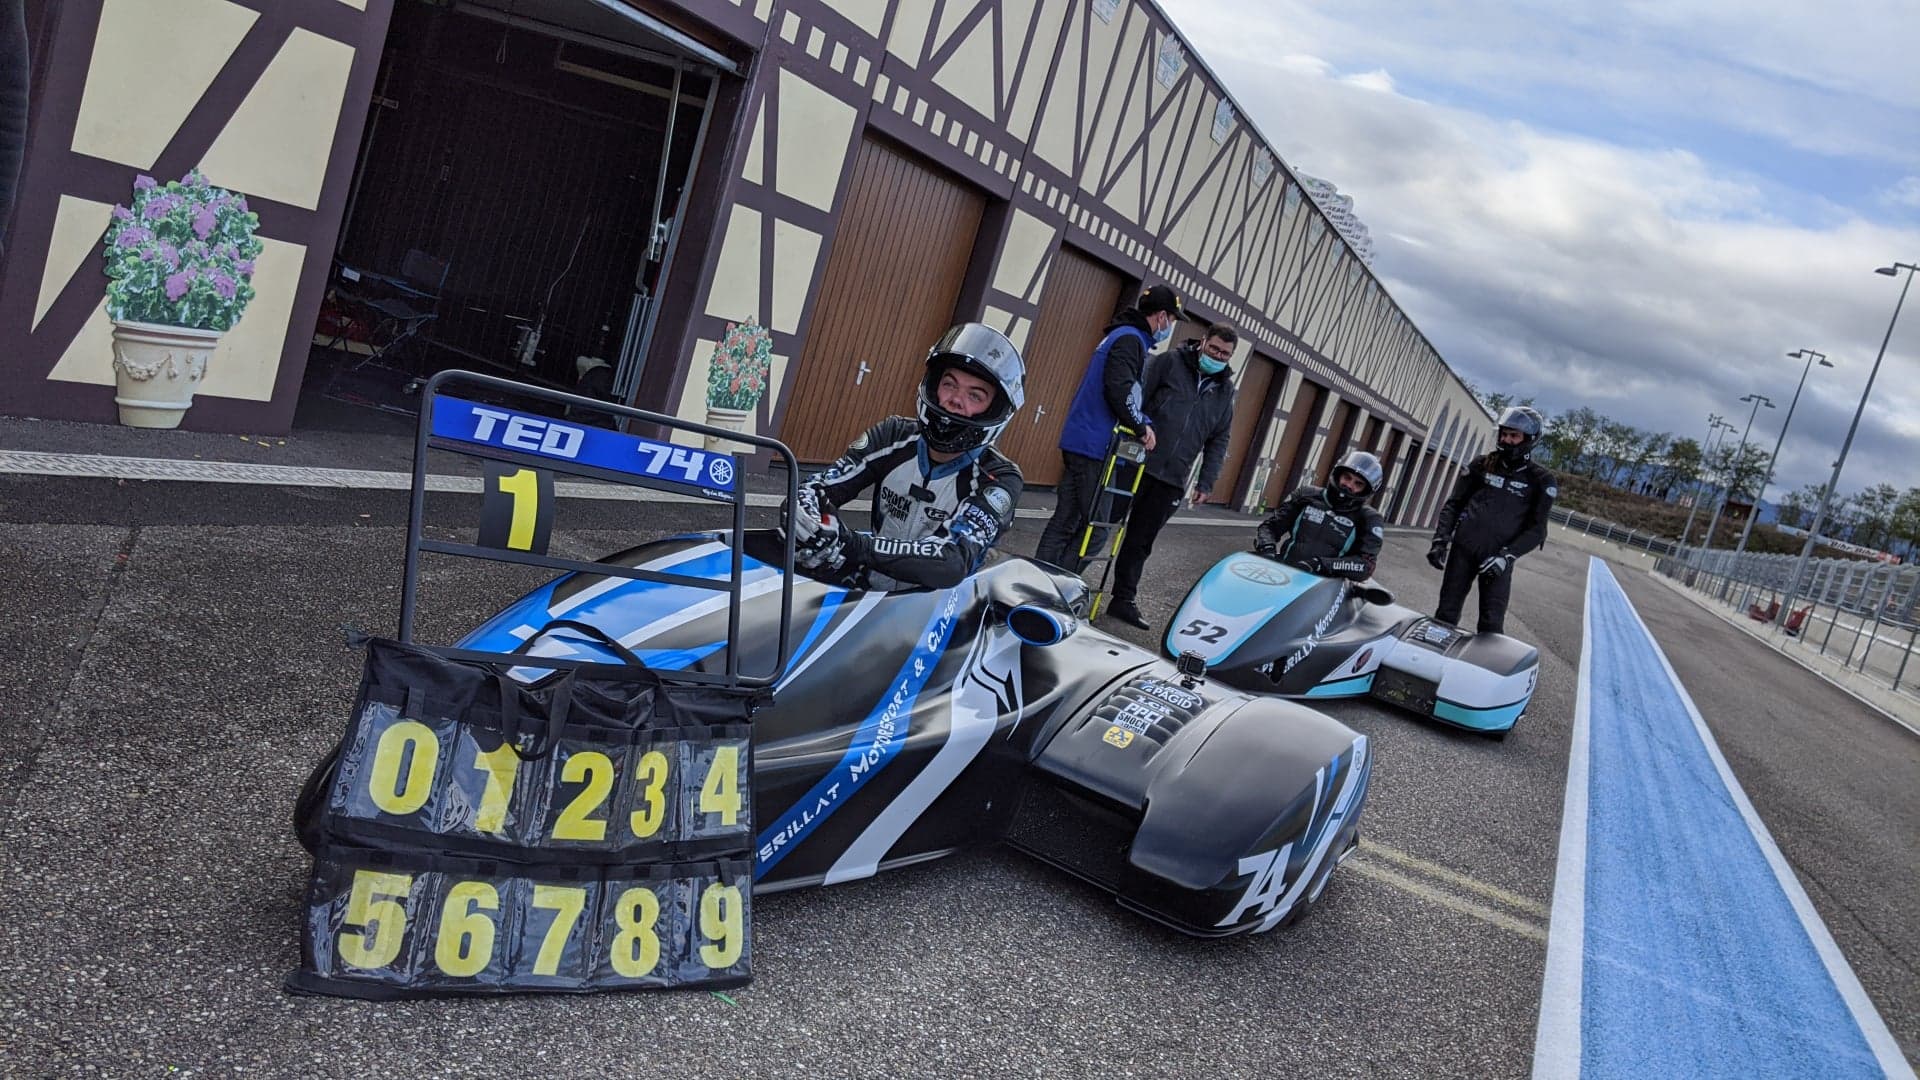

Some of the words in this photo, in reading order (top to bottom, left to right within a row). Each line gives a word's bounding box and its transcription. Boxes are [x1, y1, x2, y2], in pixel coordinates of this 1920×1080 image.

[471, 407, 585, 459] TED
[637, 441, 706, 482] 74
[498, 469, 538, 551] 1
[874, 538, 944, 557] wintex
[1332, 560, 1365, 572] wintex
[1179, 619, 1228, 644] 52
[1118, 711, 1150, 730] SHOCK
[1152, 686, 1193, 709] PAGID
[369, 721, 439, 815] 0
[474, 743, 519, 834] 1
[551, 751, 615, 841] 2
[630, 751, 668, 838] 3
[700, 746, 742, 826] 4
[756, 781, 840, 863] ERILLAT
[914, 657, 926, 678] &
[1214, 843, 1293, 927] 74
[338, 870, 412, 969] 5
[434, 881, 499, 978] 6
[532, 885, 587, 976] 7
[610, 887, 661, 978] 8
[700, 881, 744, 969] 9
